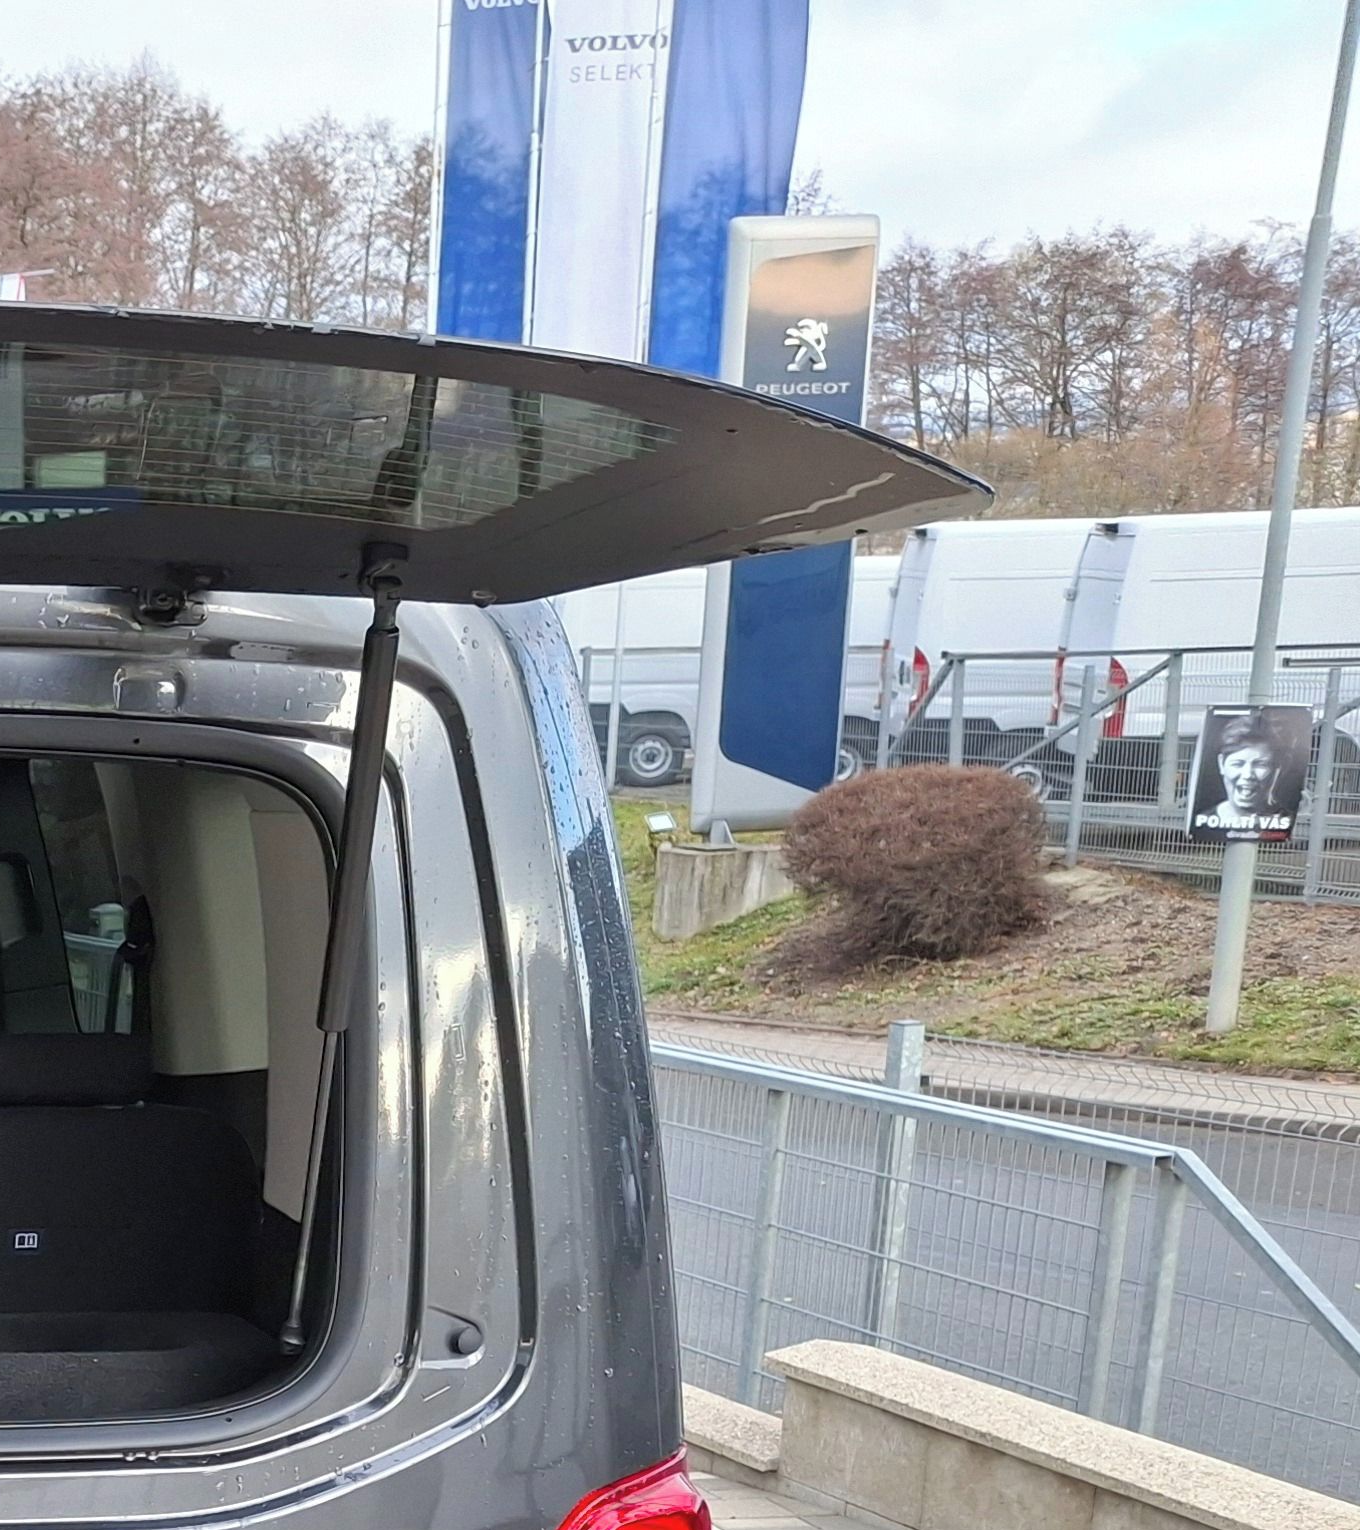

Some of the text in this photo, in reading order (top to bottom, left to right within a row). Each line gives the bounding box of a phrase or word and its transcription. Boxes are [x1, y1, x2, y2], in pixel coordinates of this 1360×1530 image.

[565, 33, 668, 53] VOLVO
[754, 381, 851, 396] PEUGEOT
[1259, 813, 1291, 830] VÁS
